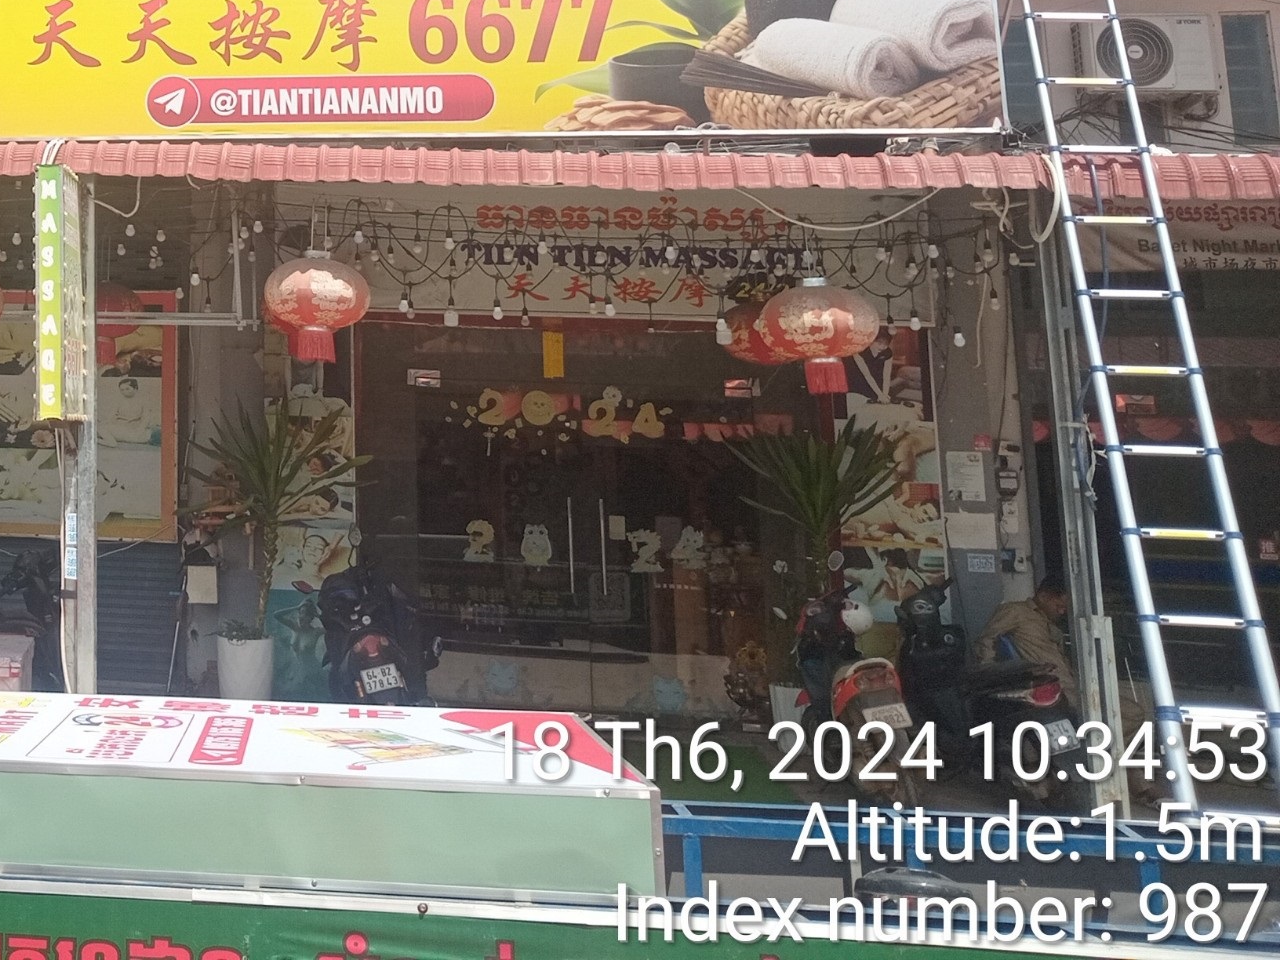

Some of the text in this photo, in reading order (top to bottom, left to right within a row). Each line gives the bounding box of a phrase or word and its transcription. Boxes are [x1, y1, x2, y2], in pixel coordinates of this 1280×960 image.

[209, 85, 445, 117] @TIANTIANANMO
[1138, 239, 1188, 253] Baet
[1194, 239, 1236, 256] Night
[40, 179, 58, 407] MASSAGE
[506, 272, 713, 308] 天天按摩
